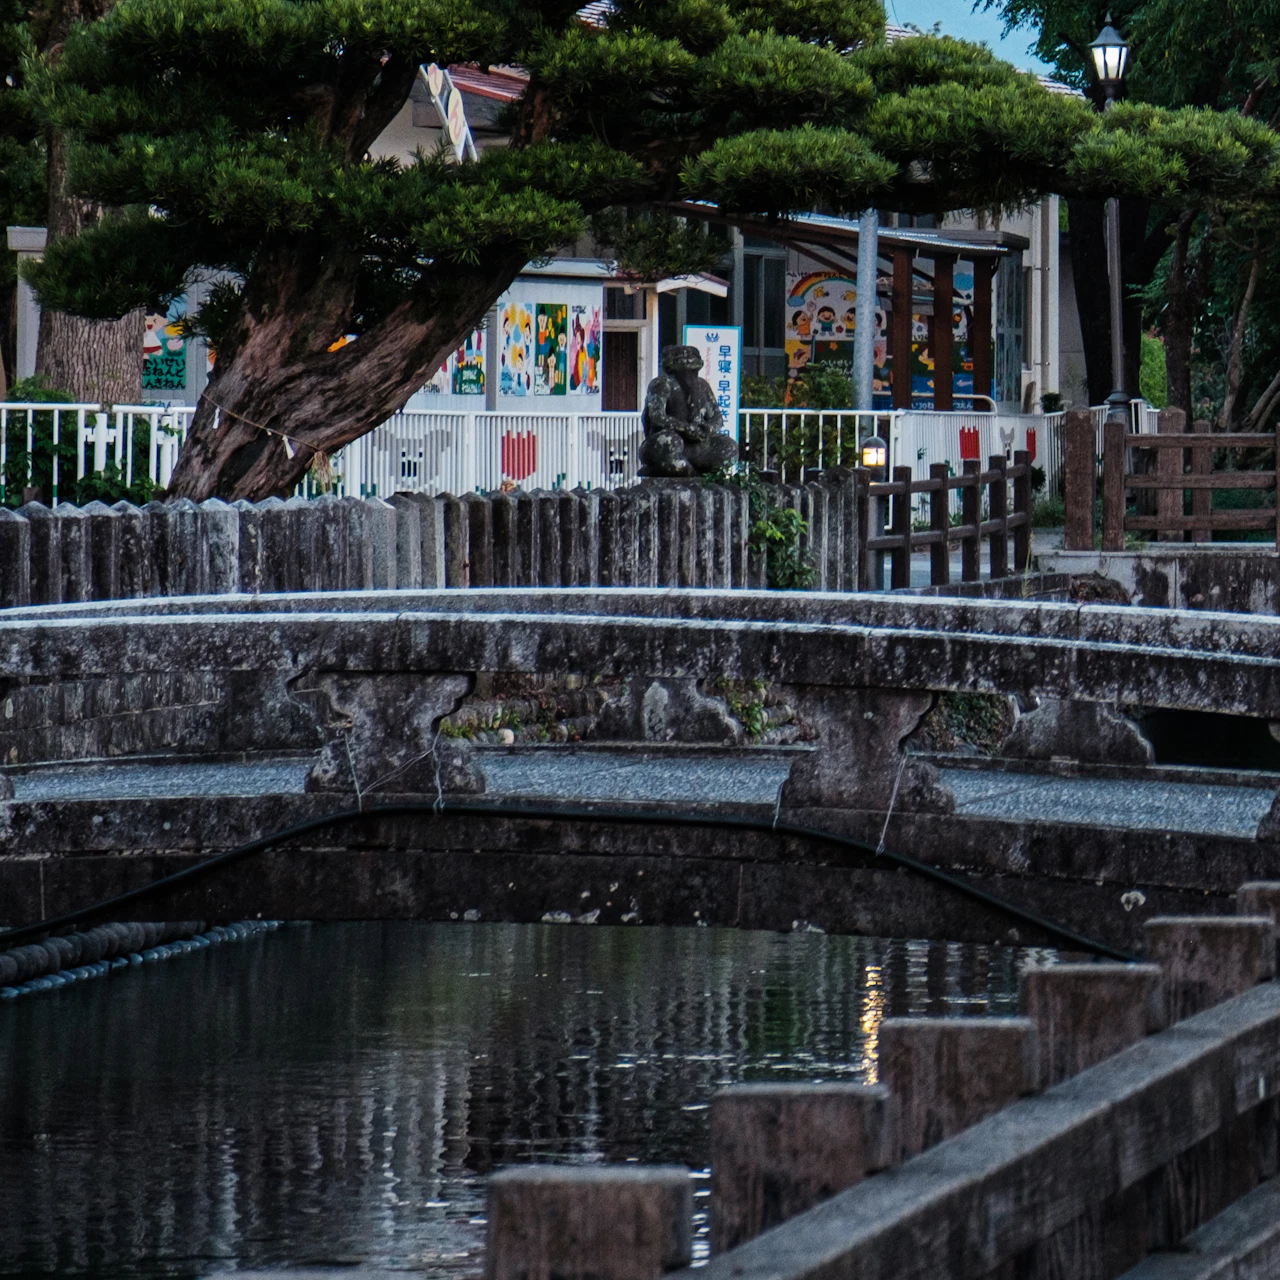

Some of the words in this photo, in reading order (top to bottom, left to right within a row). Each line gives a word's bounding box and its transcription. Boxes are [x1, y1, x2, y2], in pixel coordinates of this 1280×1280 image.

[820, 359, 852, 367] へいせい
[142, 378, 185, 389] んきねん
